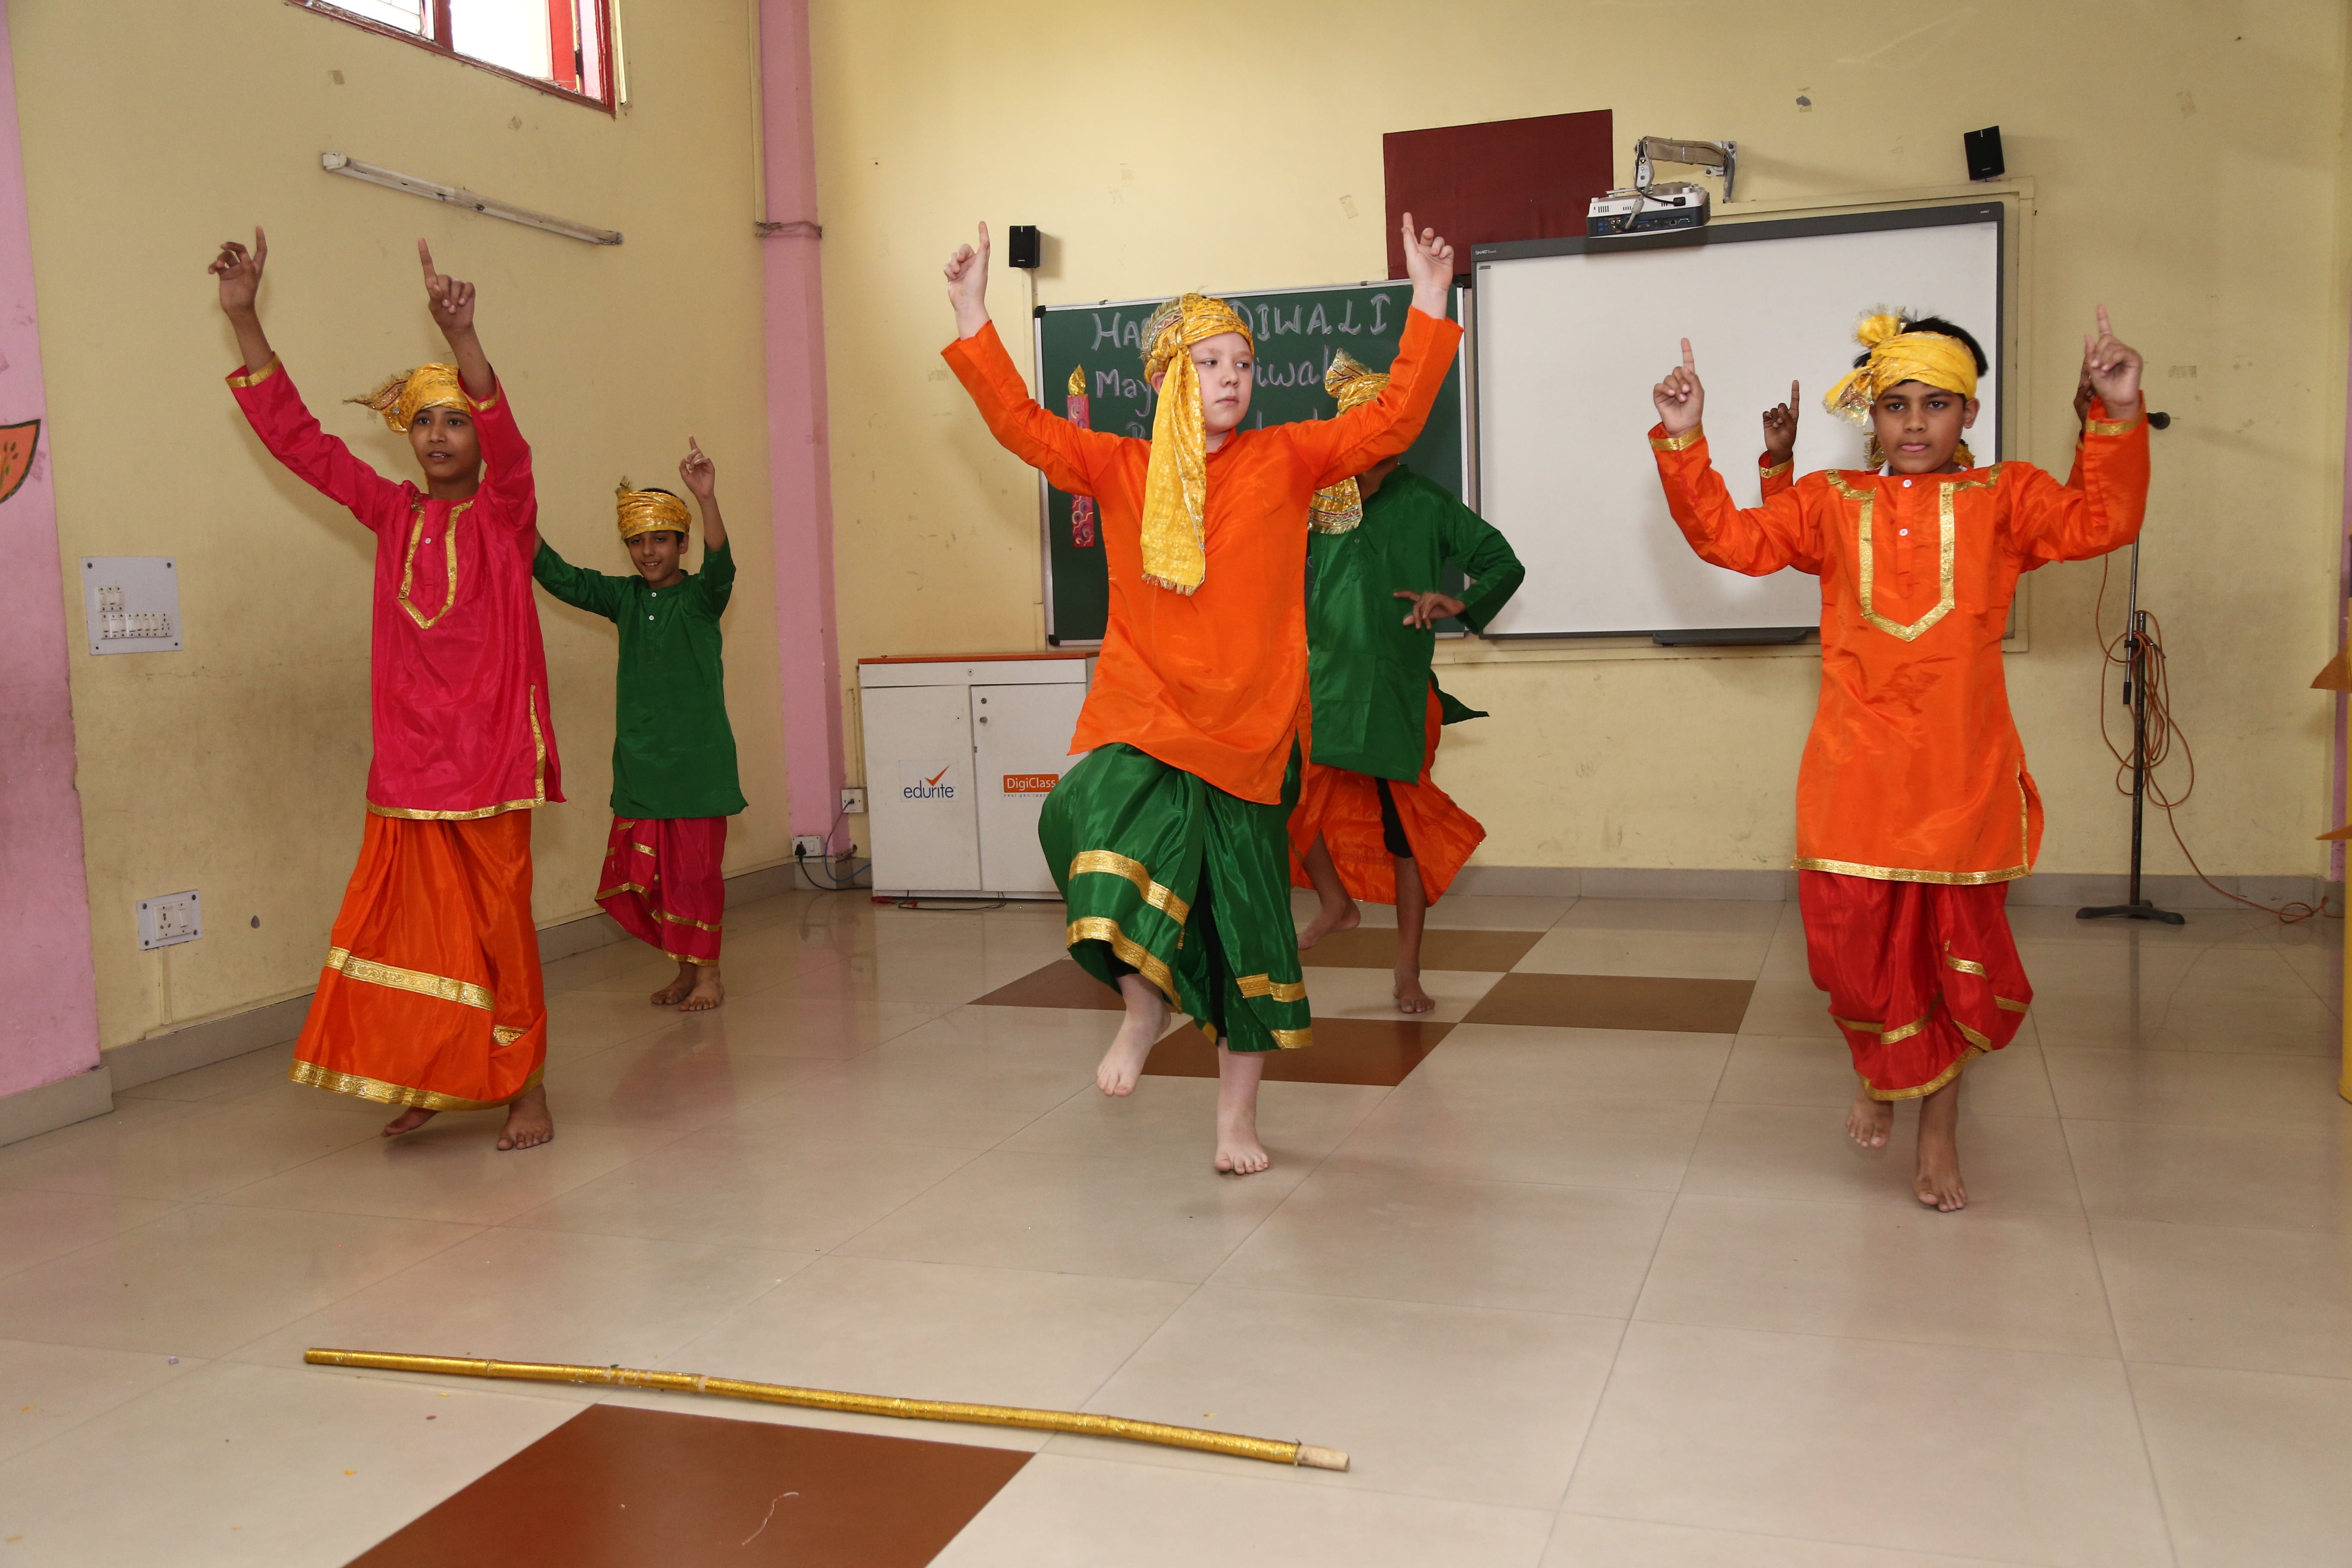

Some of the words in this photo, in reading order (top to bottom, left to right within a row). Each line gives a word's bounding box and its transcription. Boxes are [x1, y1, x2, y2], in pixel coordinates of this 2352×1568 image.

[1096, 368, 1152, 417] May
[1251, 344, 1329, 387] iwal
[903, 780, 954, 798] edurite
[1007, 777, 1056, 791] DigiClass
